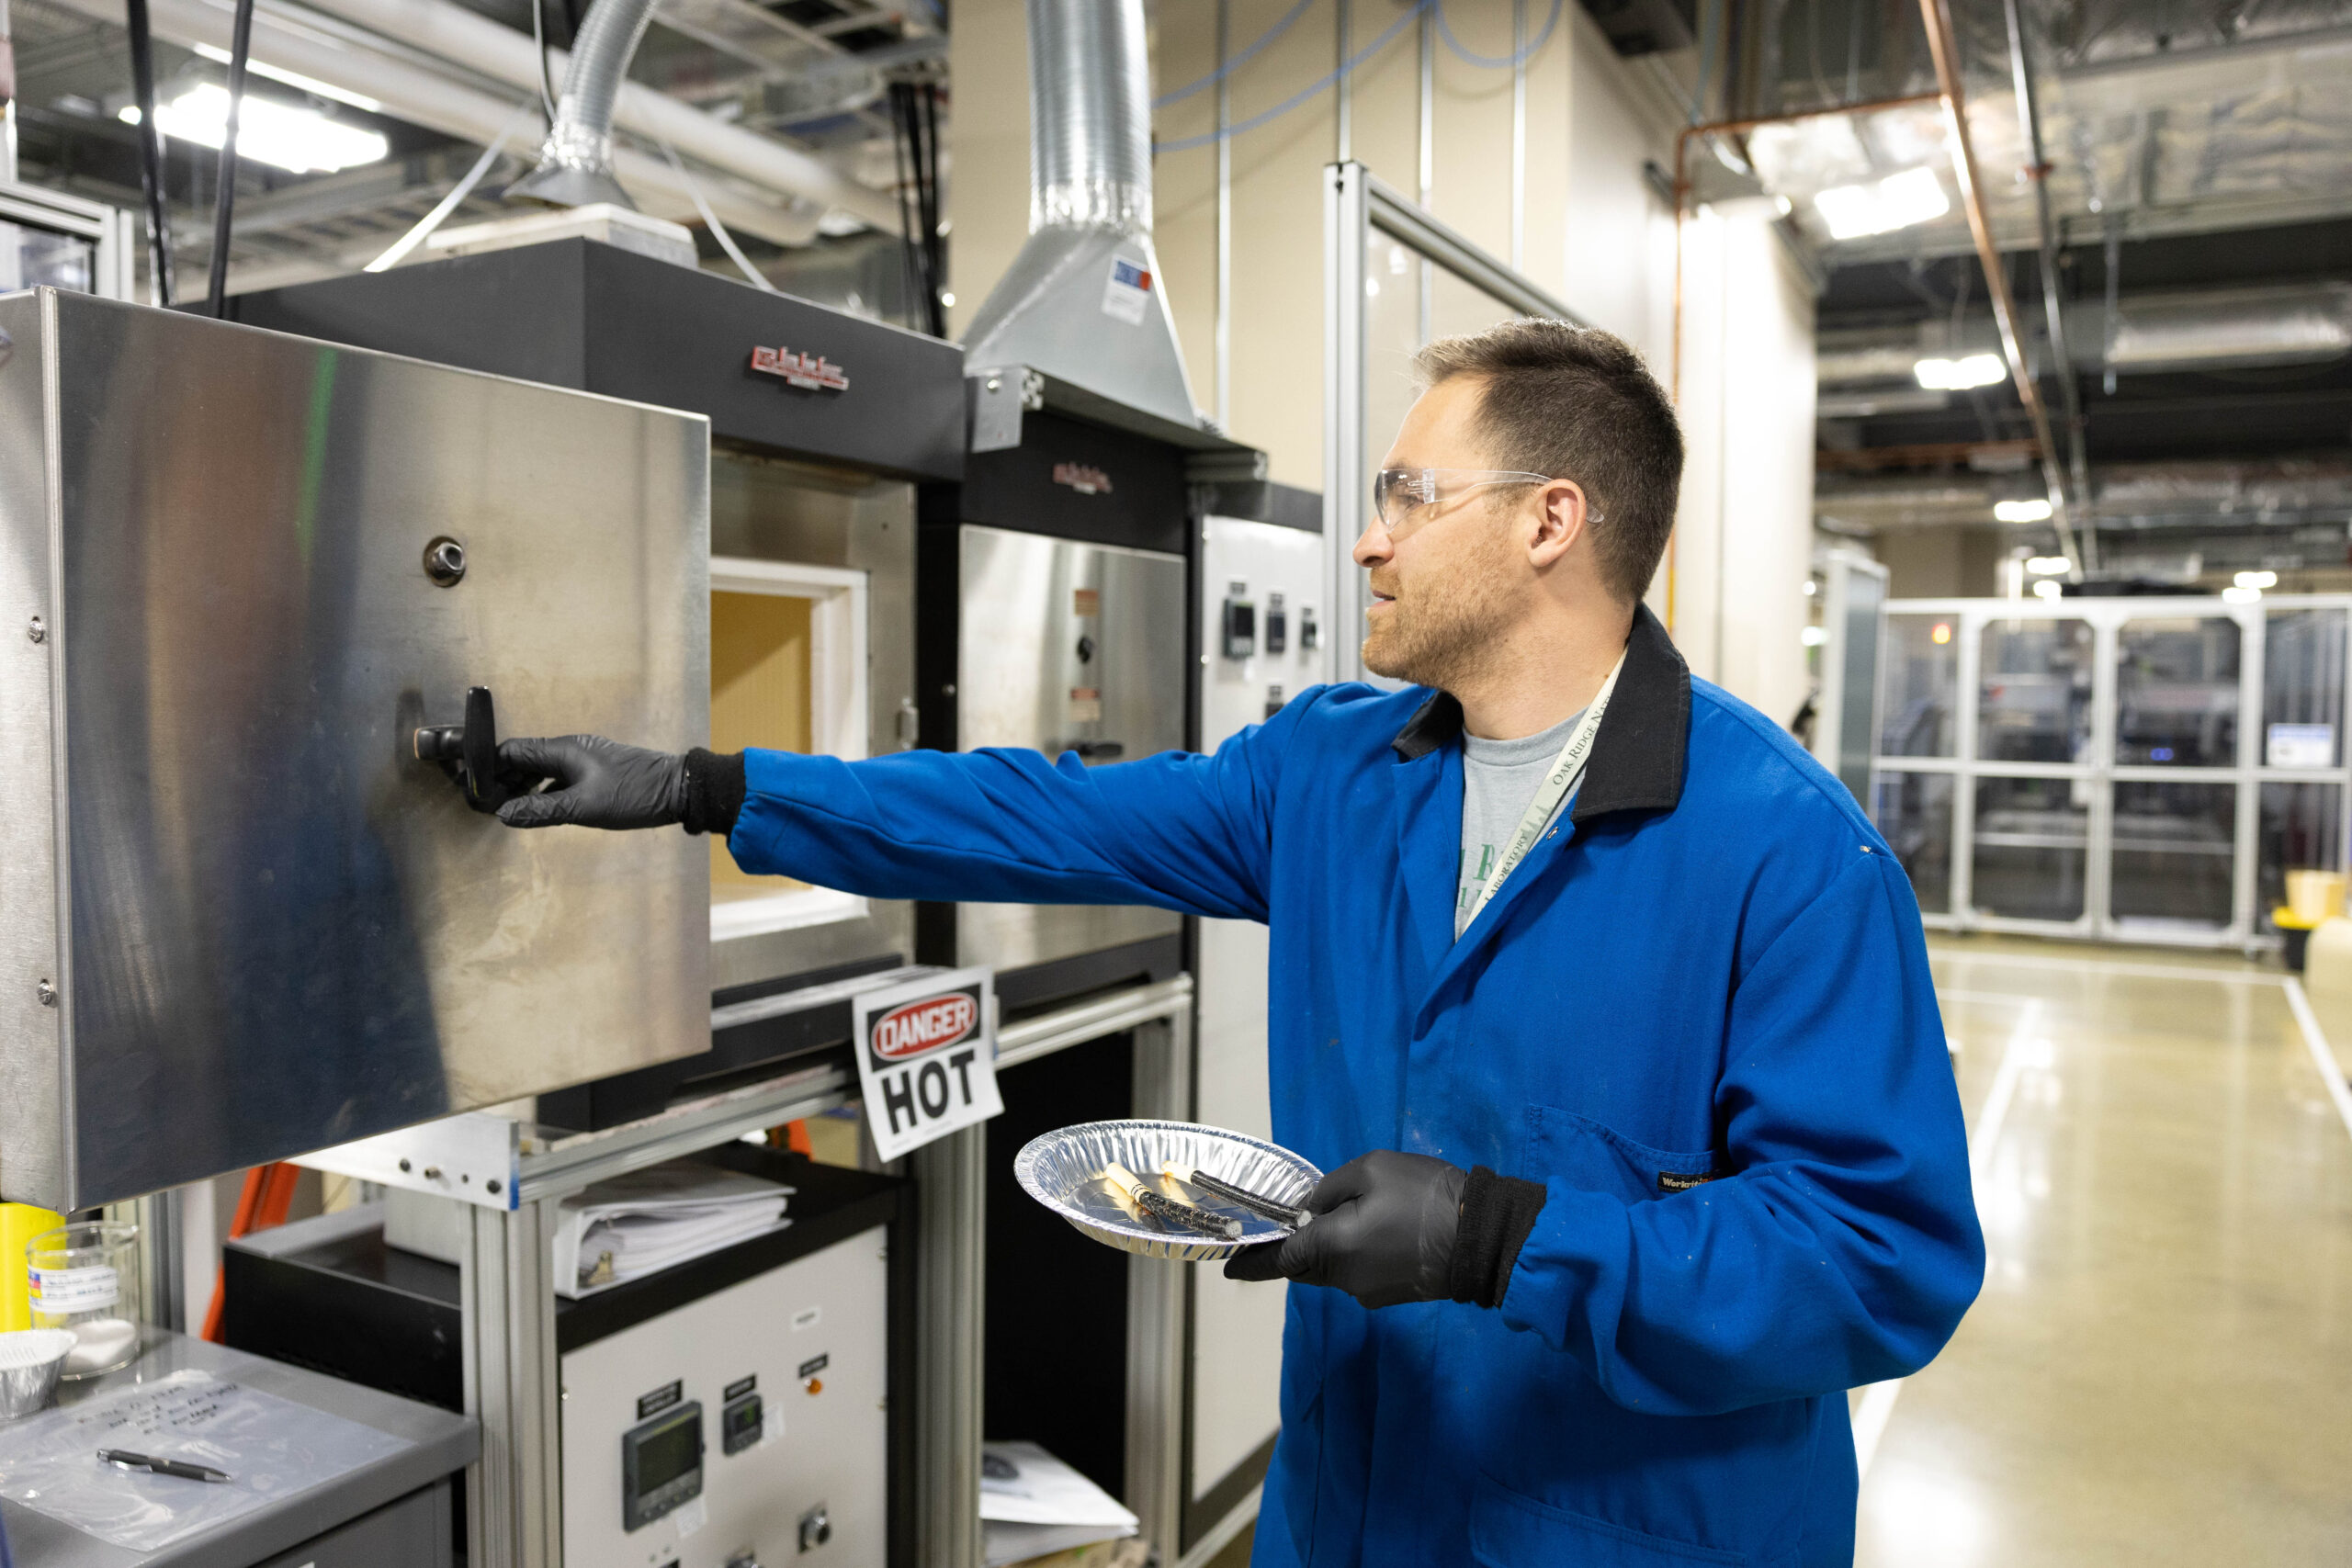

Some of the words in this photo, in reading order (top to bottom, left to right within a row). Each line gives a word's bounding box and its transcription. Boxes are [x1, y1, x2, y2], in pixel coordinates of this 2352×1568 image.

[1553, 760, 1573, 784] OAK
[1568, 724, 1596, 759] RIDGE
[880, 999, 971, 1054] DANGER
[882, 1048, 975, 1134] HOT
